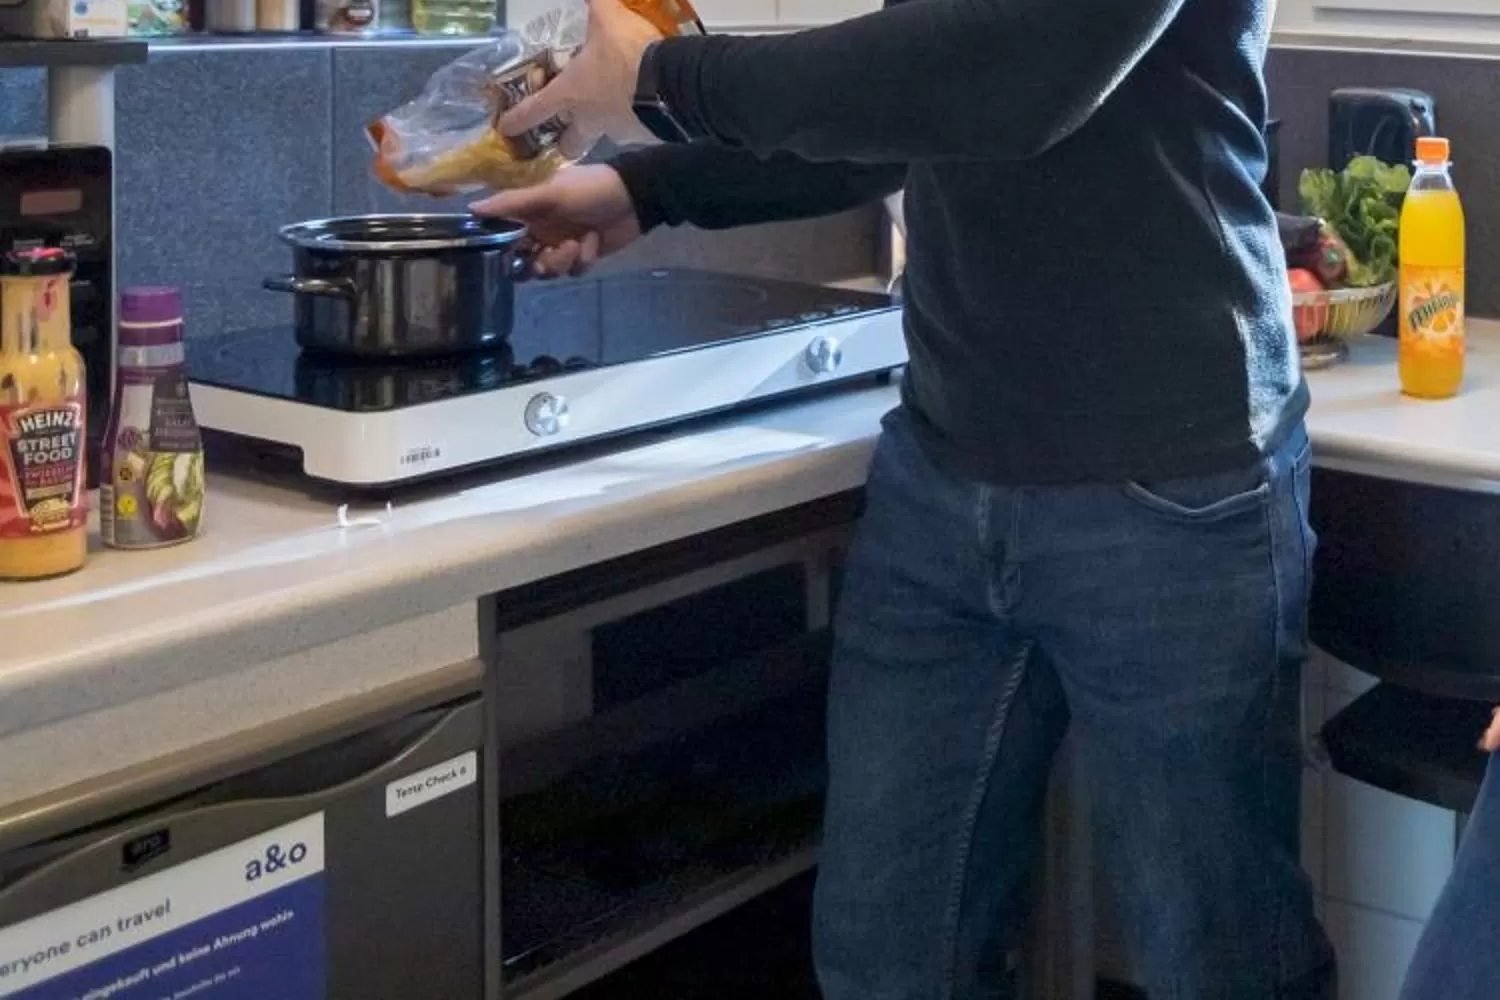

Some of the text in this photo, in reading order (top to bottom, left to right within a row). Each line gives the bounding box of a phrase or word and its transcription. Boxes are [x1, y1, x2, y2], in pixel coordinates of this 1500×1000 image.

[20, 411, 73, 433] HEINZ
[17, 432, 77, 453] STREET
[24, 447, 72, 465] FOOD
[245, 842, 307, 881] a&o
[75, 925, 112, 949] can
[117, 898, 171, 933] travel
[152, 956, 177, 976] und
[213, 924, 259, 950] Ahnung
